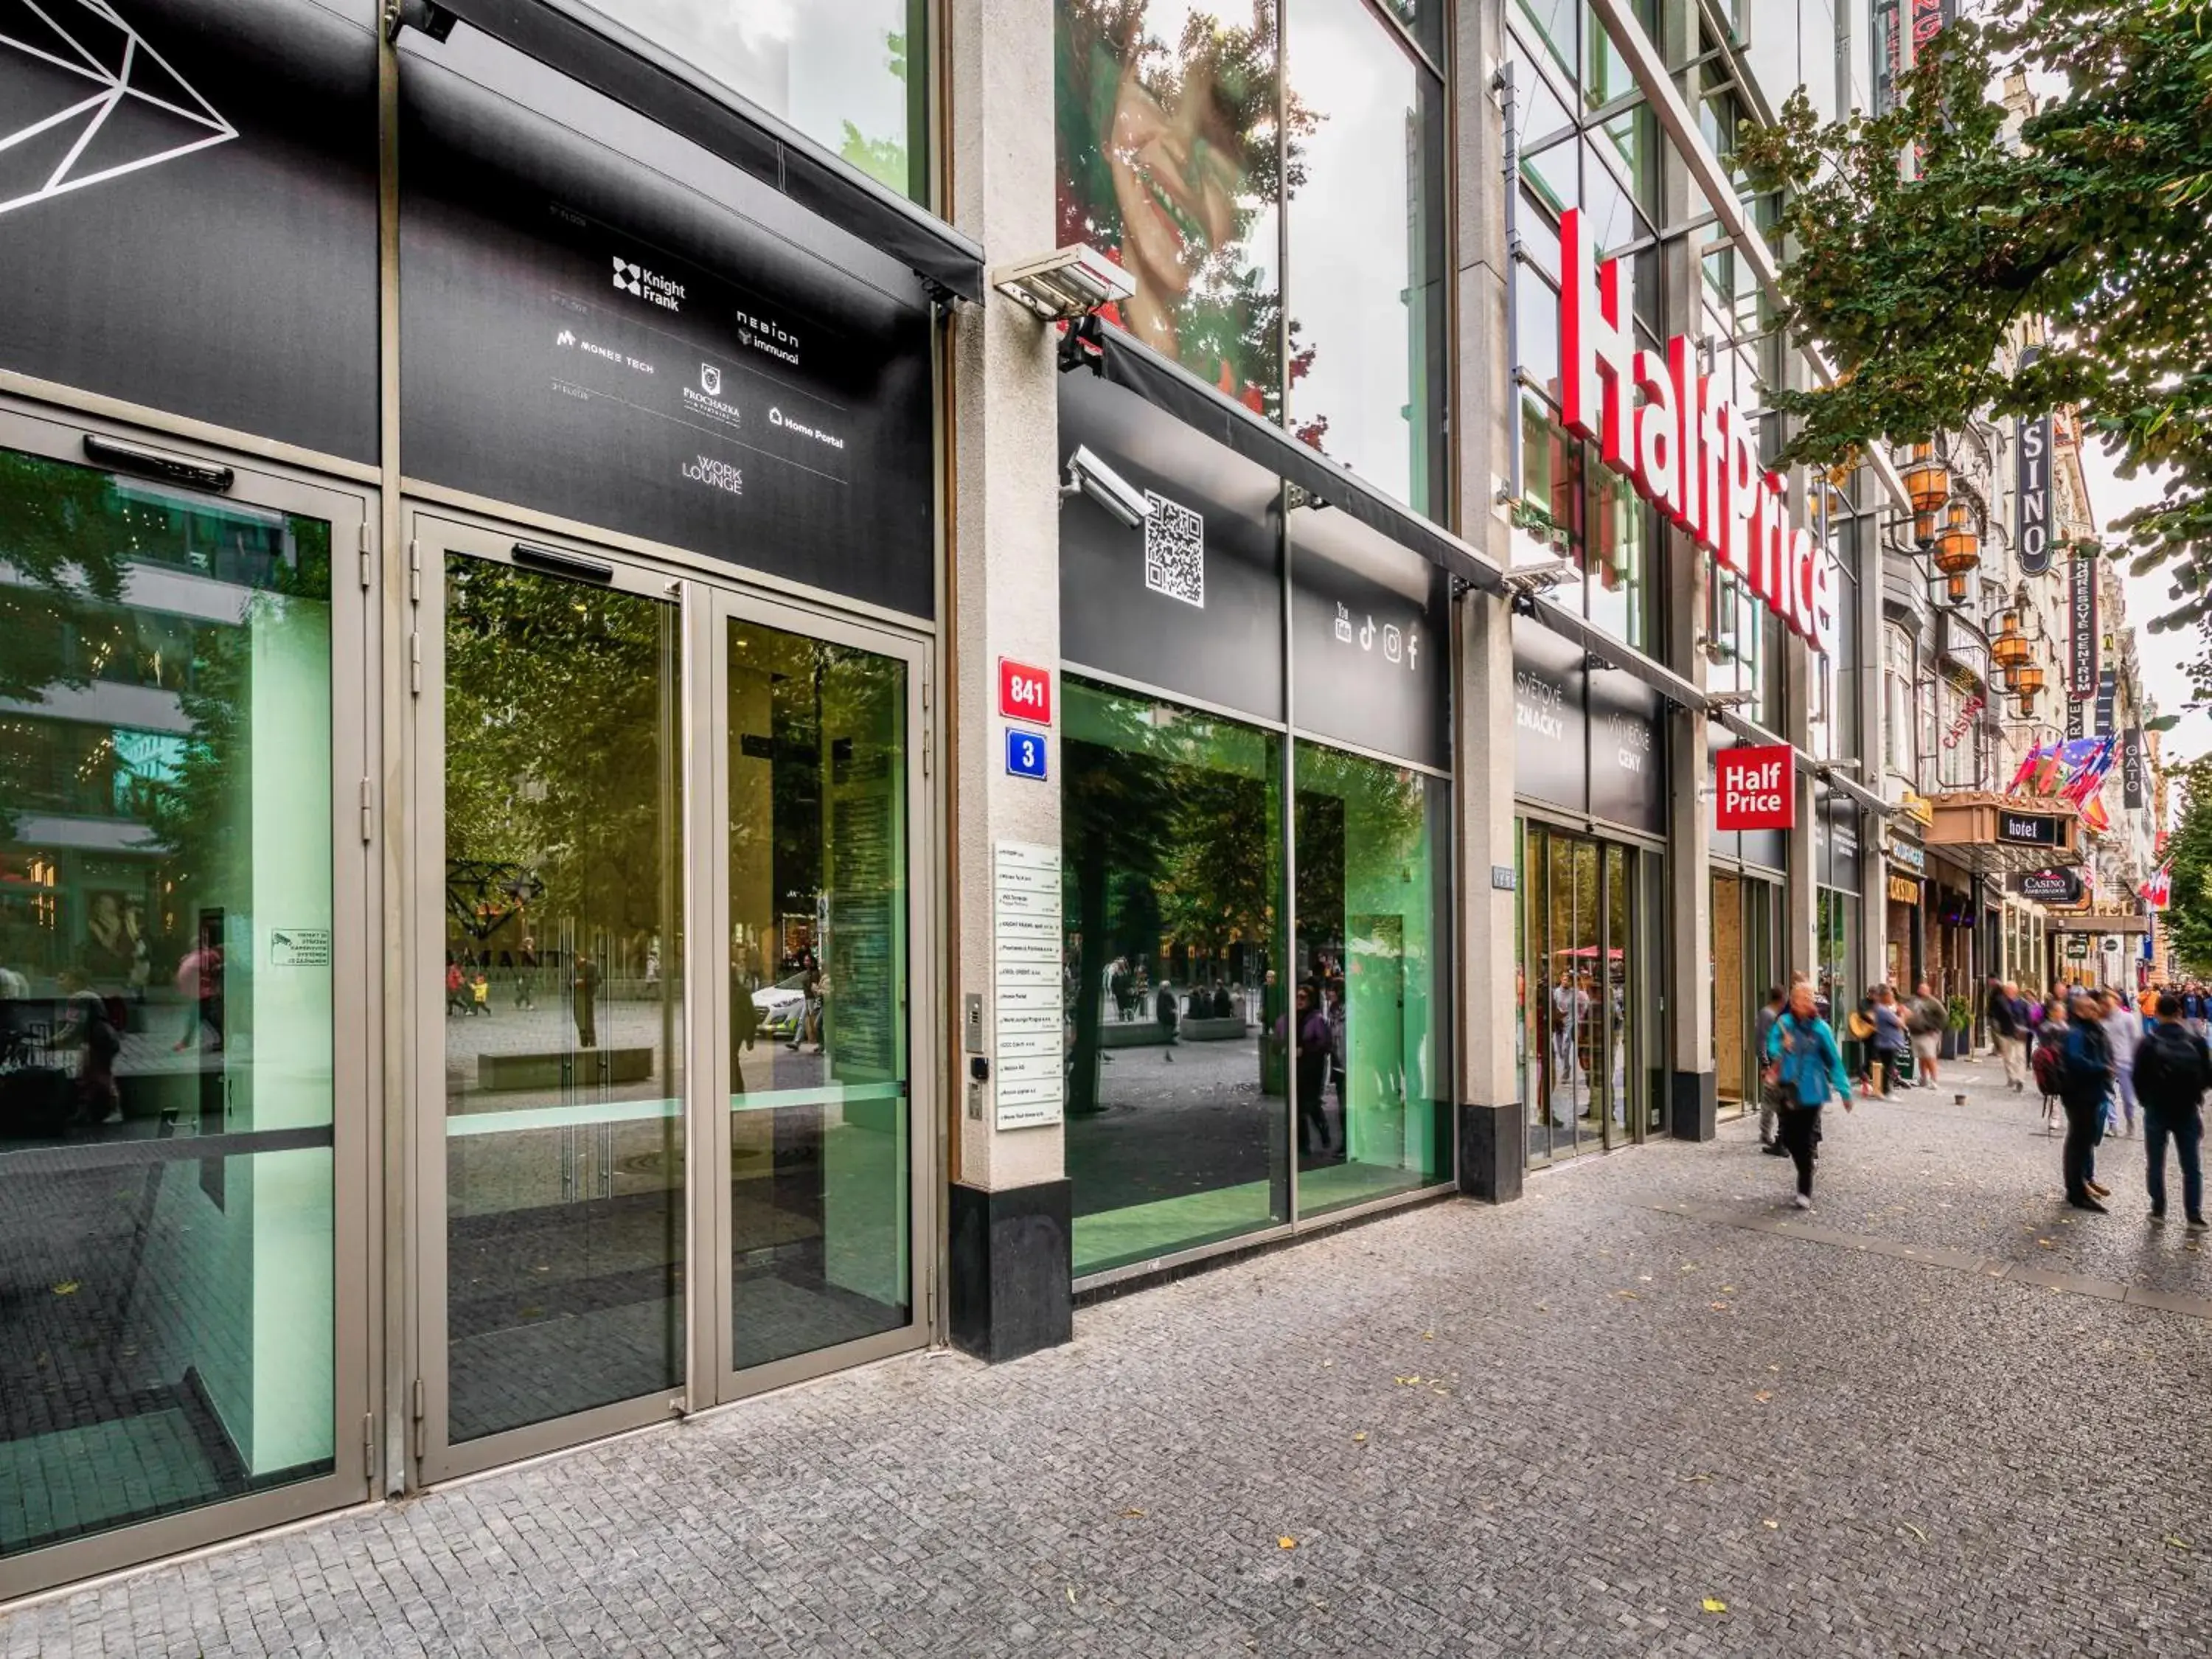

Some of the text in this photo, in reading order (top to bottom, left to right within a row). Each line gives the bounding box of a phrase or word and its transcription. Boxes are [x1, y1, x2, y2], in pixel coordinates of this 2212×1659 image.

[643, 269, 686, 299] Knight
[643, 286, 679, 312] Frank
[625, 356, 655, 374] TECH
[754, 335, 799, 365] immunai
[785, 417, 844, 449] Home Portal
[682, 462, 743, 495] LOUNGE
[697, 453, 743, 485] WORK
[2023, 414, 2046, 556] SINO
[2076, 635, 2091, 692] CENTRUM
[1011, 675, 1043, 708] 841
[1516, 703, 1563, 742] ZNAČKY
[1022, 740, 1034, 768] 3
[1618, 746, 1641, 773] CENY
[1725, 762, 1782, 792] Half
[1725, 792, 1782, 813] Price
[2008, 818, 2037, 838] hotel
